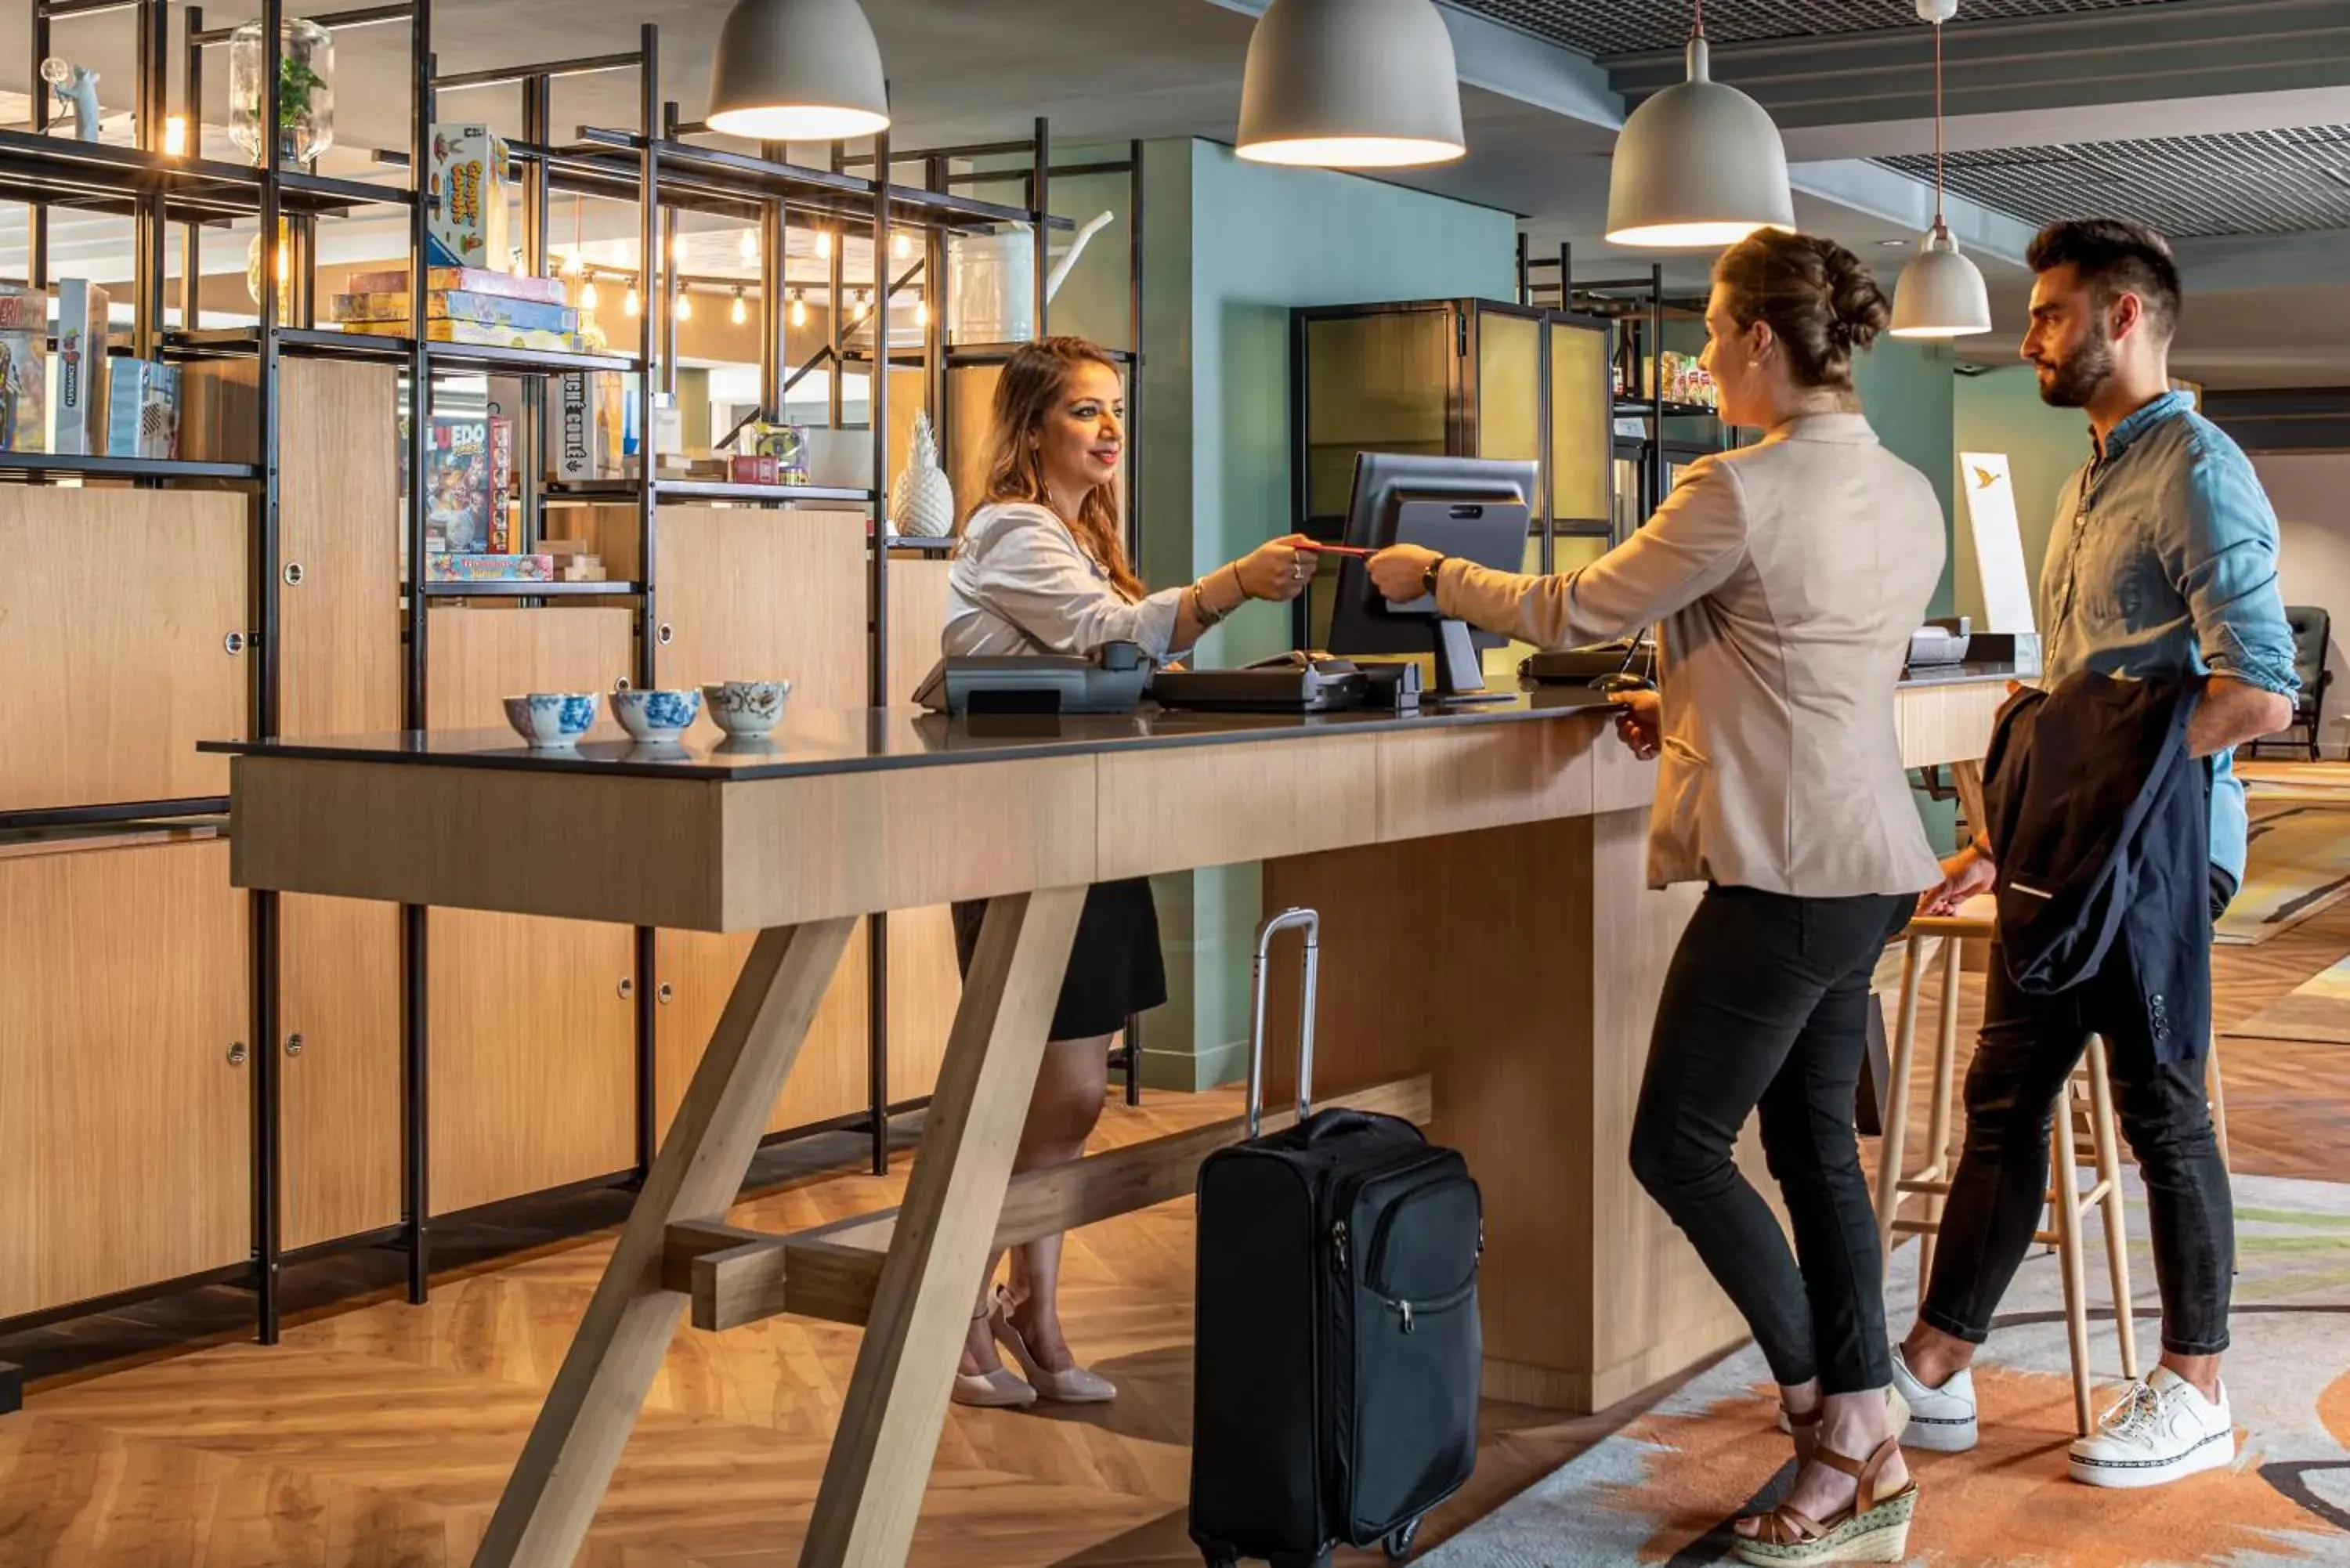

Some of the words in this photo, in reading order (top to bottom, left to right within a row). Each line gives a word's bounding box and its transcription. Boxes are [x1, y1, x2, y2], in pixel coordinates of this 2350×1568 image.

[565, 372, 588, 409] UCHÉ
[427, 423, 486, 451] LUEDO
[565, 411, 588, 458] COULÉ
